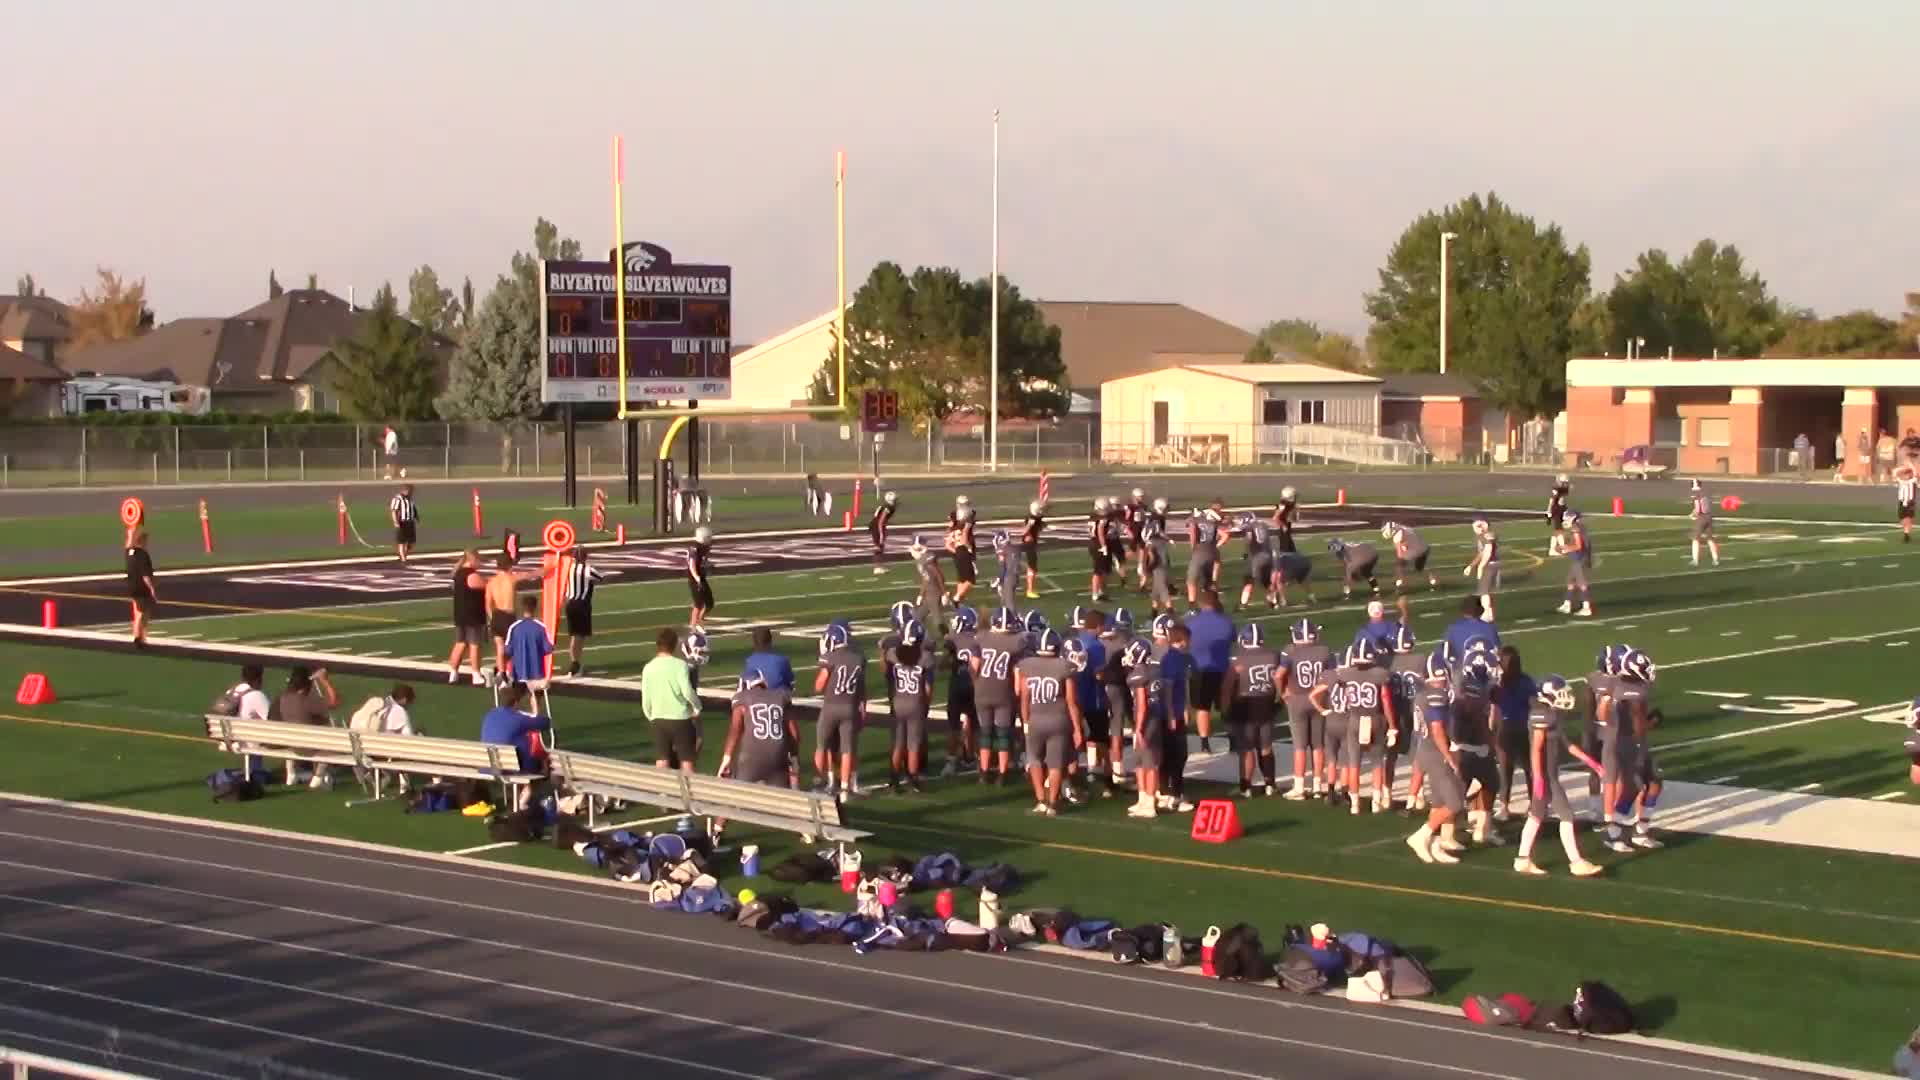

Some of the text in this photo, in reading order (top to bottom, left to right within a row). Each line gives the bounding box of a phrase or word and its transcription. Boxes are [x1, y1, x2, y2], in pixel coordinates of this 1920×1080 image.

[980, 649, 1010, 680] 74
[1026, 676, 1059, 704] 70
[750, 703, 784, 740] 58
[1195, 806, 1227, 834] 30
